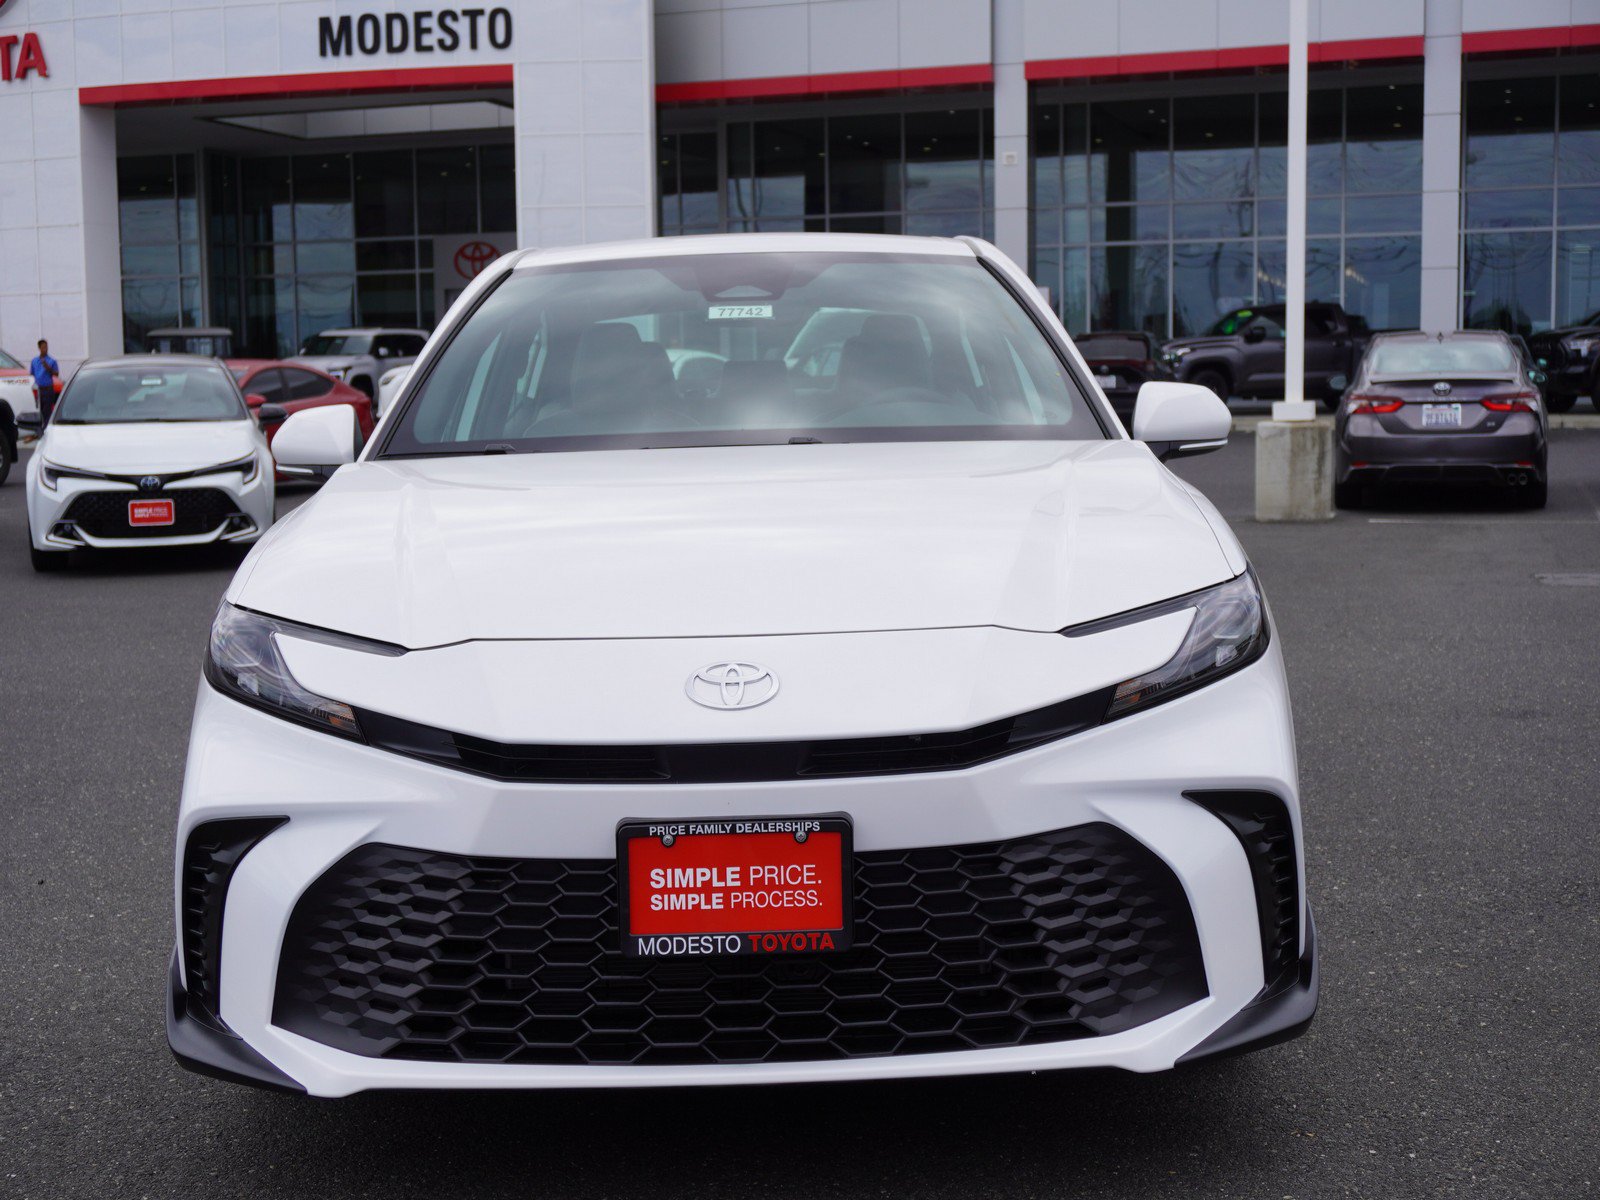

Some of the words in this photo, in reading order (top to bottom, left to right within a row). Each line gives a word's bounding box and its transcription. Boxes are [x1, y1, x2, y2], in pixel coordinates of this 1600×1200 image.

[319, 7, 512, 57] MODESTO
[718, 307, 763, 317] 77742
[650, 825, 685, 836] PRICE
[689, 823, 732, 835] FAMILY
[736, 821, 820, 834] DEALERSHIPS
[650, 866, 741, 889] SIMPLE
[750, 864, 822, 886] PRICE.
[650, 892, 724, 911] SIMPLE
[730, 890, 823, 909] PROCESS.
[638, 935, 741, 956] MODESTO
[748, 932, 835, 953] TOYOTA
